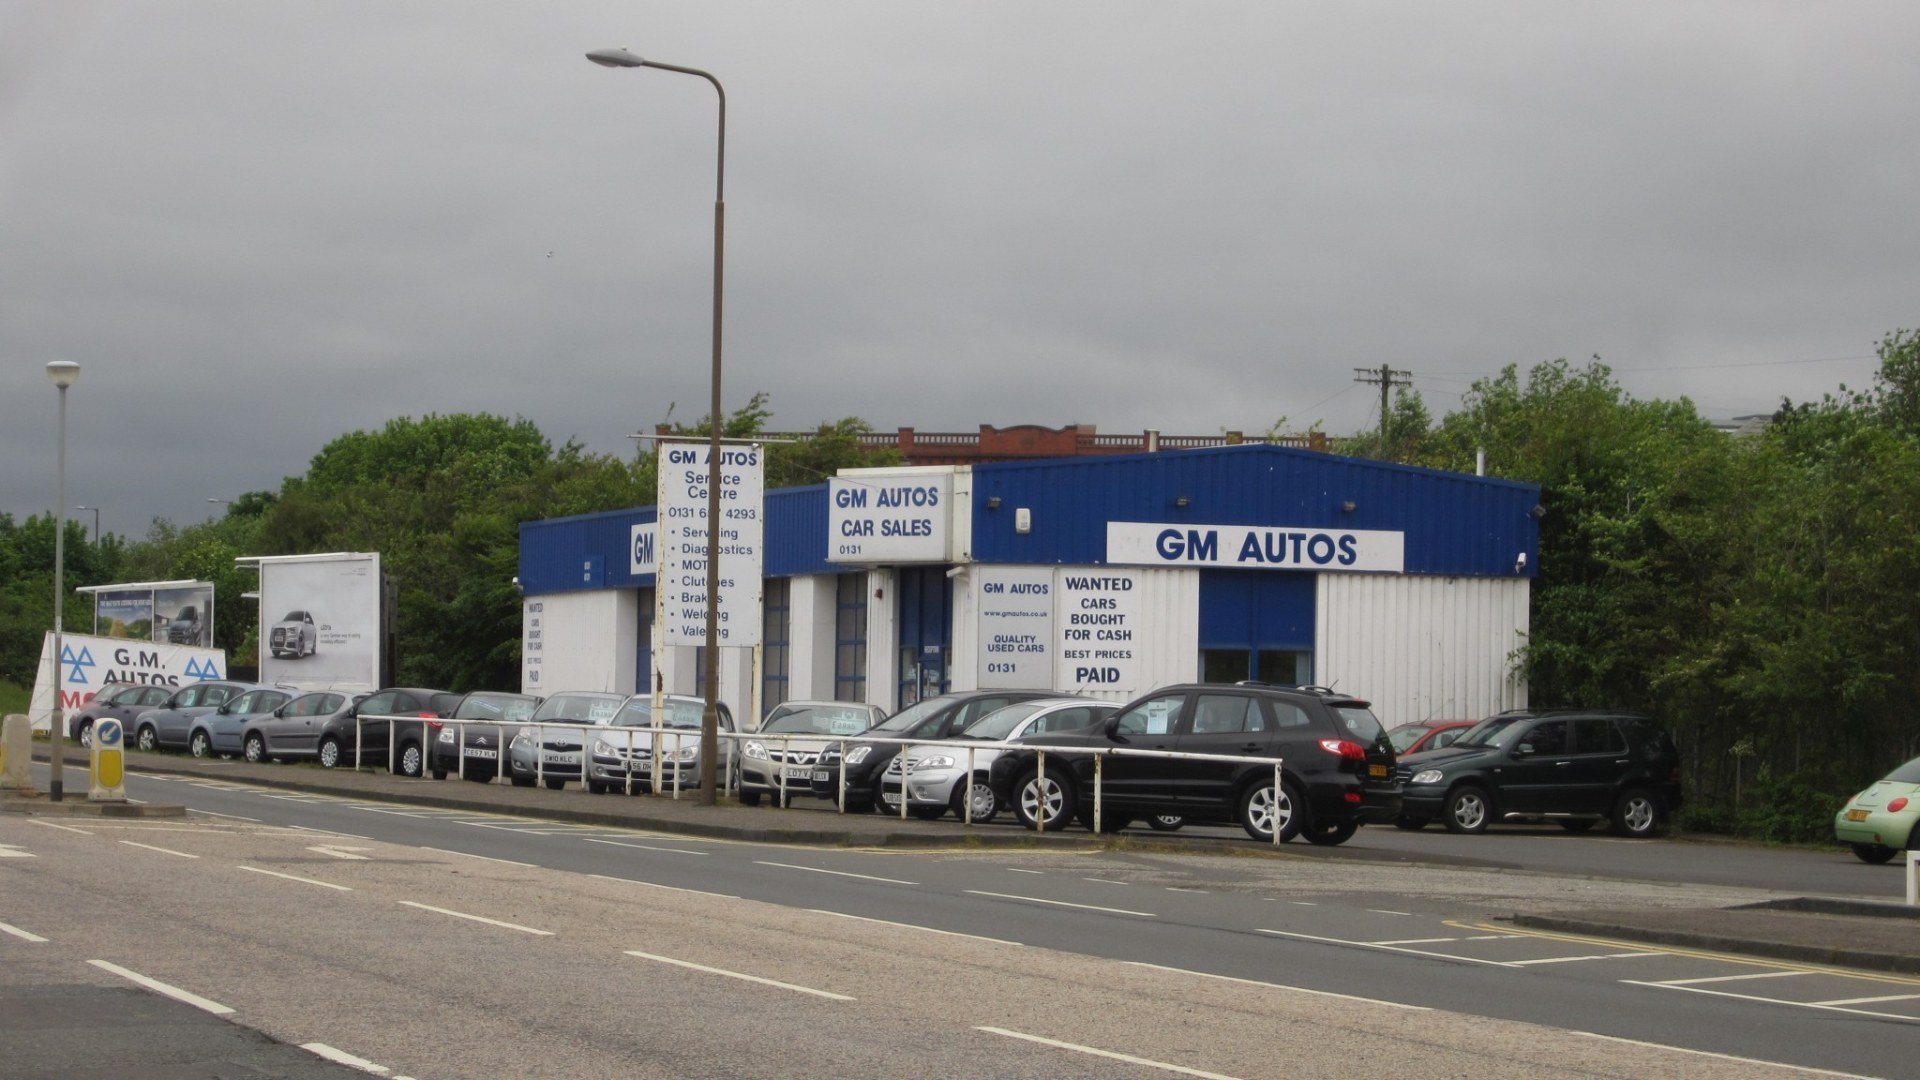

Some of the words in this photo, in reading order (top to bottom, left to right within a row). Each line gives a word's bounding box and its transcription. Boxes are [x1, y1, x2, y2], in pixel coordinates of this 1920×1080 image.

[669, 450, 696, 464] GM
[685, 471, 741, 485] Serice
[688, 486, 738, 499] Cere
[836, 488, 867, 508] GM
[876, 486, 938, 508] AUTOS
[668, 507, 694, 518] 0131
[725, 508, 756, 519] 4293
[682, 526, 738, 540] Serving
[841, 519, 874, 537] CAR
[881, 519, 932, 537] SALES
[634, 532, 654, 565] GM
[682, 543, 753, 556] Diagostics
[839, 545, 862, 555] 0131
[1156, 528, 1218, 561] GM
[1237, 531, 1358, 566] AUTOS
[682, 575, 735, 587] Clutes
[1065, 577, 1133, 591] WANTED
[984, 583, 1004, 594] GM
[1010, 583, 1049, 595] AUTOS
[681, 592, 723, 603] Braks
[1081, 598, 1117, 609] CARS
[1071, 613, 1125, 625] BOUGHT
[994, 635, 1036, 644] QUALITY
[1064, 629, 1091, 641] FOR
[1096, 630, 1132, 641] CASH
[987, 644, 1014, 653] USED
[1017, 644, 1045, 653] CARS
[1064, 650, 1091, 659] BEST
[1095, 650, 1132, 659] PRICES
[114, 648, 166, 669] G.M.
[988, 663, 1016, 673] 0131
[1076, 667, 1121, 683] PAID
